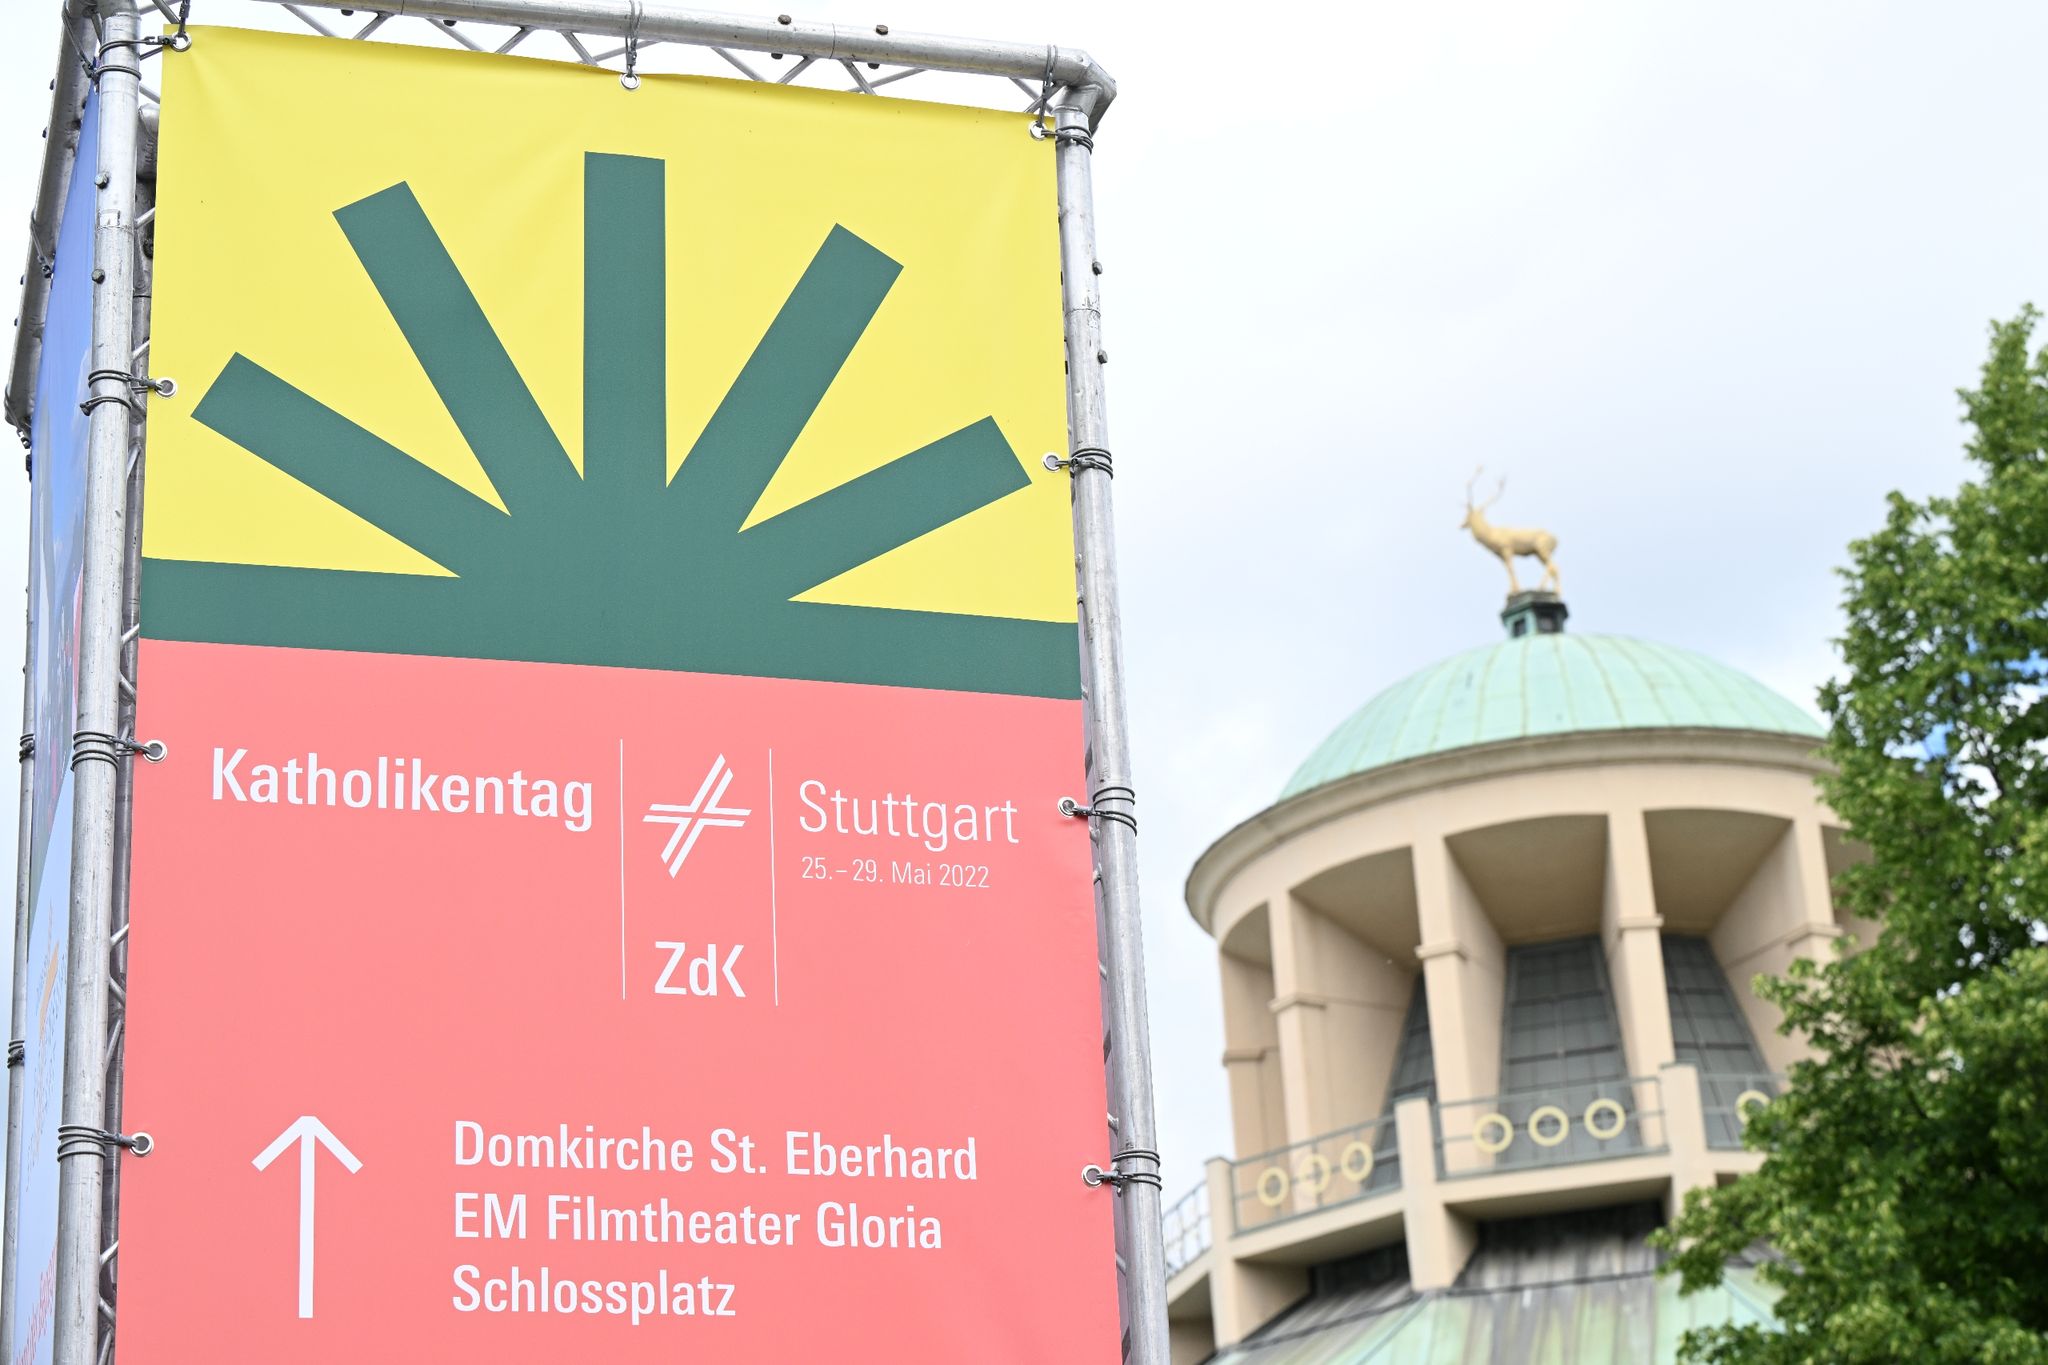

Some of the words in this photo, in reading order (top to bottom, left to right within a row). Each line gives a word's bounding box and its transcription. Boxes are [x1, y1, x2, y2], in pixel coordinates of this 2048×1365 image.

[211, 746, 593, 833] Katholikentag
[798, 779, 1020, 853] Stuttgart
[891, 860, 933, 885] Mai
[938, 863, 990, 889] 2022
[654, 940, 746, 998] ZdK
[455, 1120, 694, 1173] Domkirche
[709, 1127, 768, 1175] St.
[786, 1130, 978, 1181] Eberhard
[455, 1192, 527, 1240] EM
[548, 1194, 801, 1247] Filmtheater
[816, 1201, 943, 1250] Gloria
[452, 1264, 736, 1327] Schlossplatz
